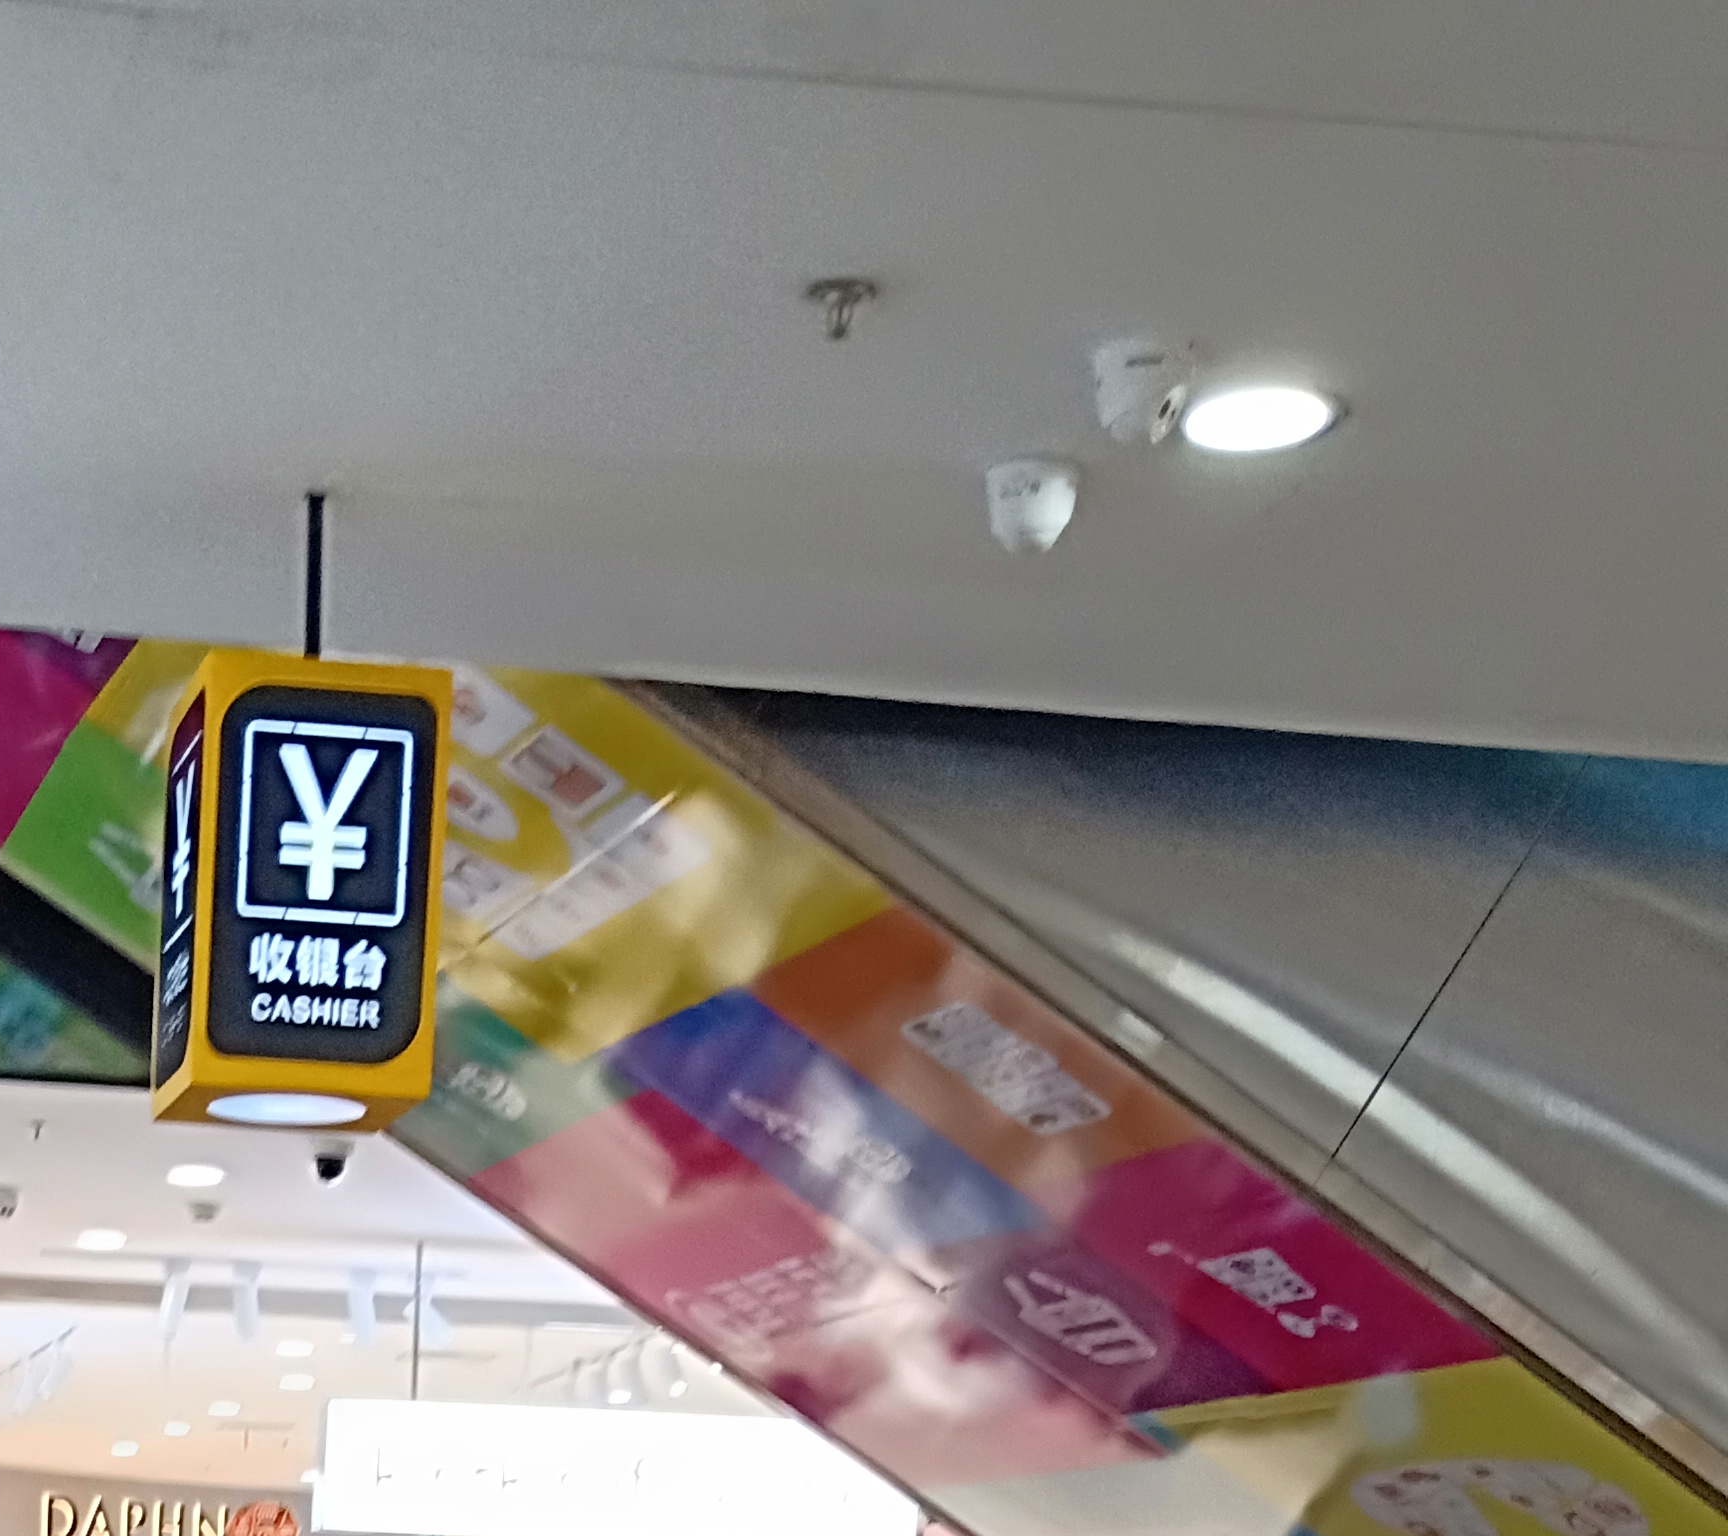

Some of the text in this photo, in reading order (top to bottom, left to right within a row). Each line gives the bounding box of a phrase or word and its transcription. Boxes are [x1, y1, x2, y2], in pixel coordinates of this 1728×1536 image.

[249, 932, 387, 991] 收银台
[250, 992, 381, 1030] CASHIER
